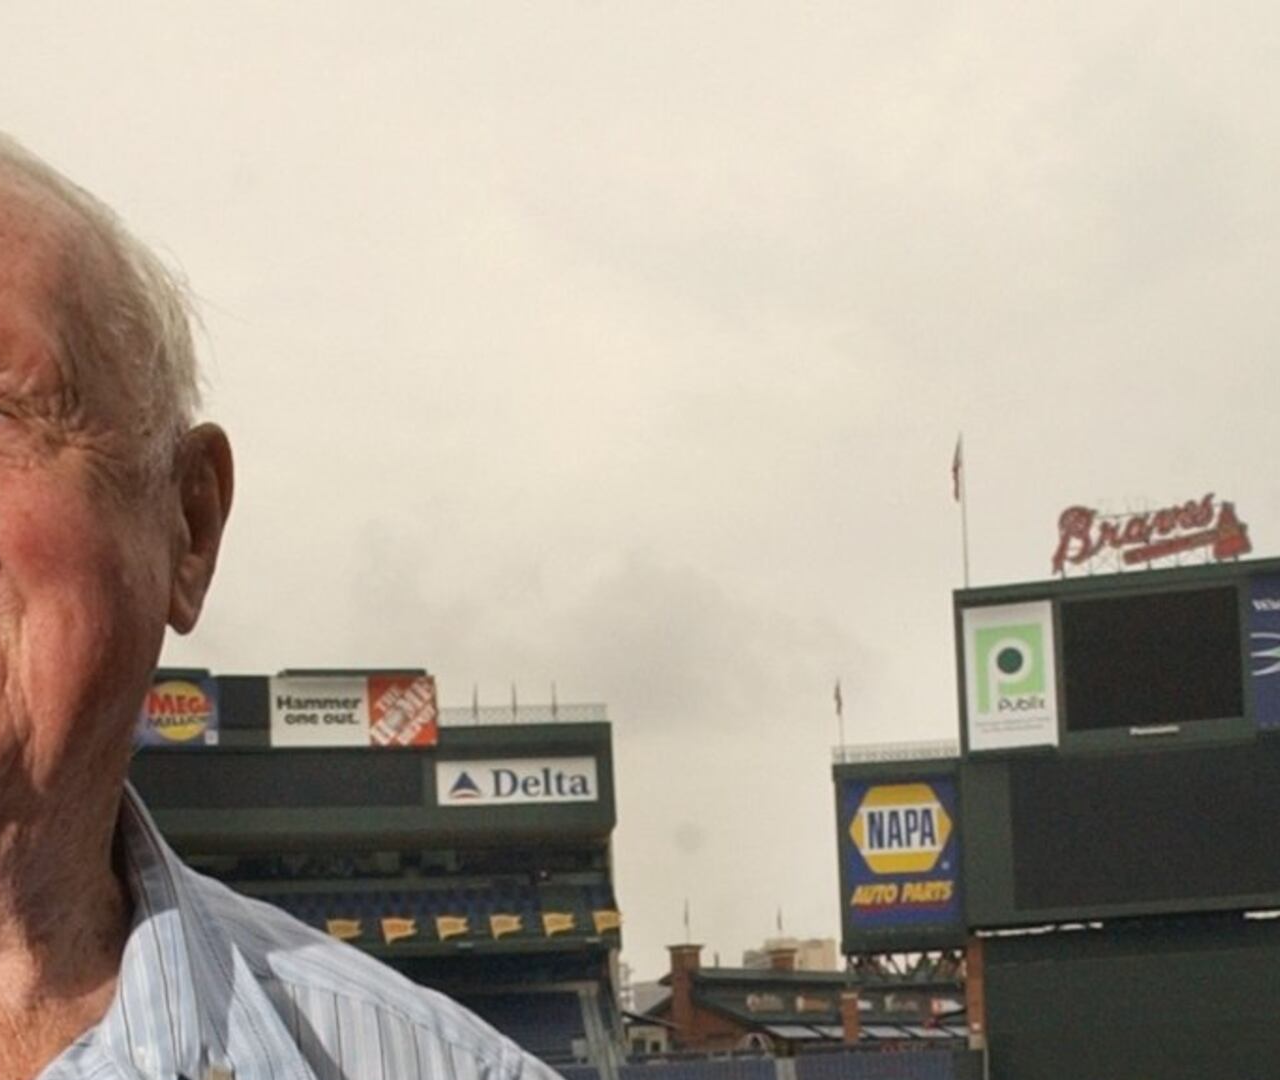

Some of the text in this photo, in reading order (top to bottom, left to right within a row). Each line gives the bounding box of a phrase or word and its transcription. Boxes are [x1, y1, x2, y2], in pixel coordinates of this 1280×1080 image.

[1053, 493, 1216, 575] Braves
[277, 695, 362, 710] Hammer
[998, 697, 1045, 712] Publix
[285, 713, 318, 725] one
[491, 767, 590, 798] Delta
[867, 808, 936, 850] NAPA
[851, 881, 955, 906] AUTO PARTS
